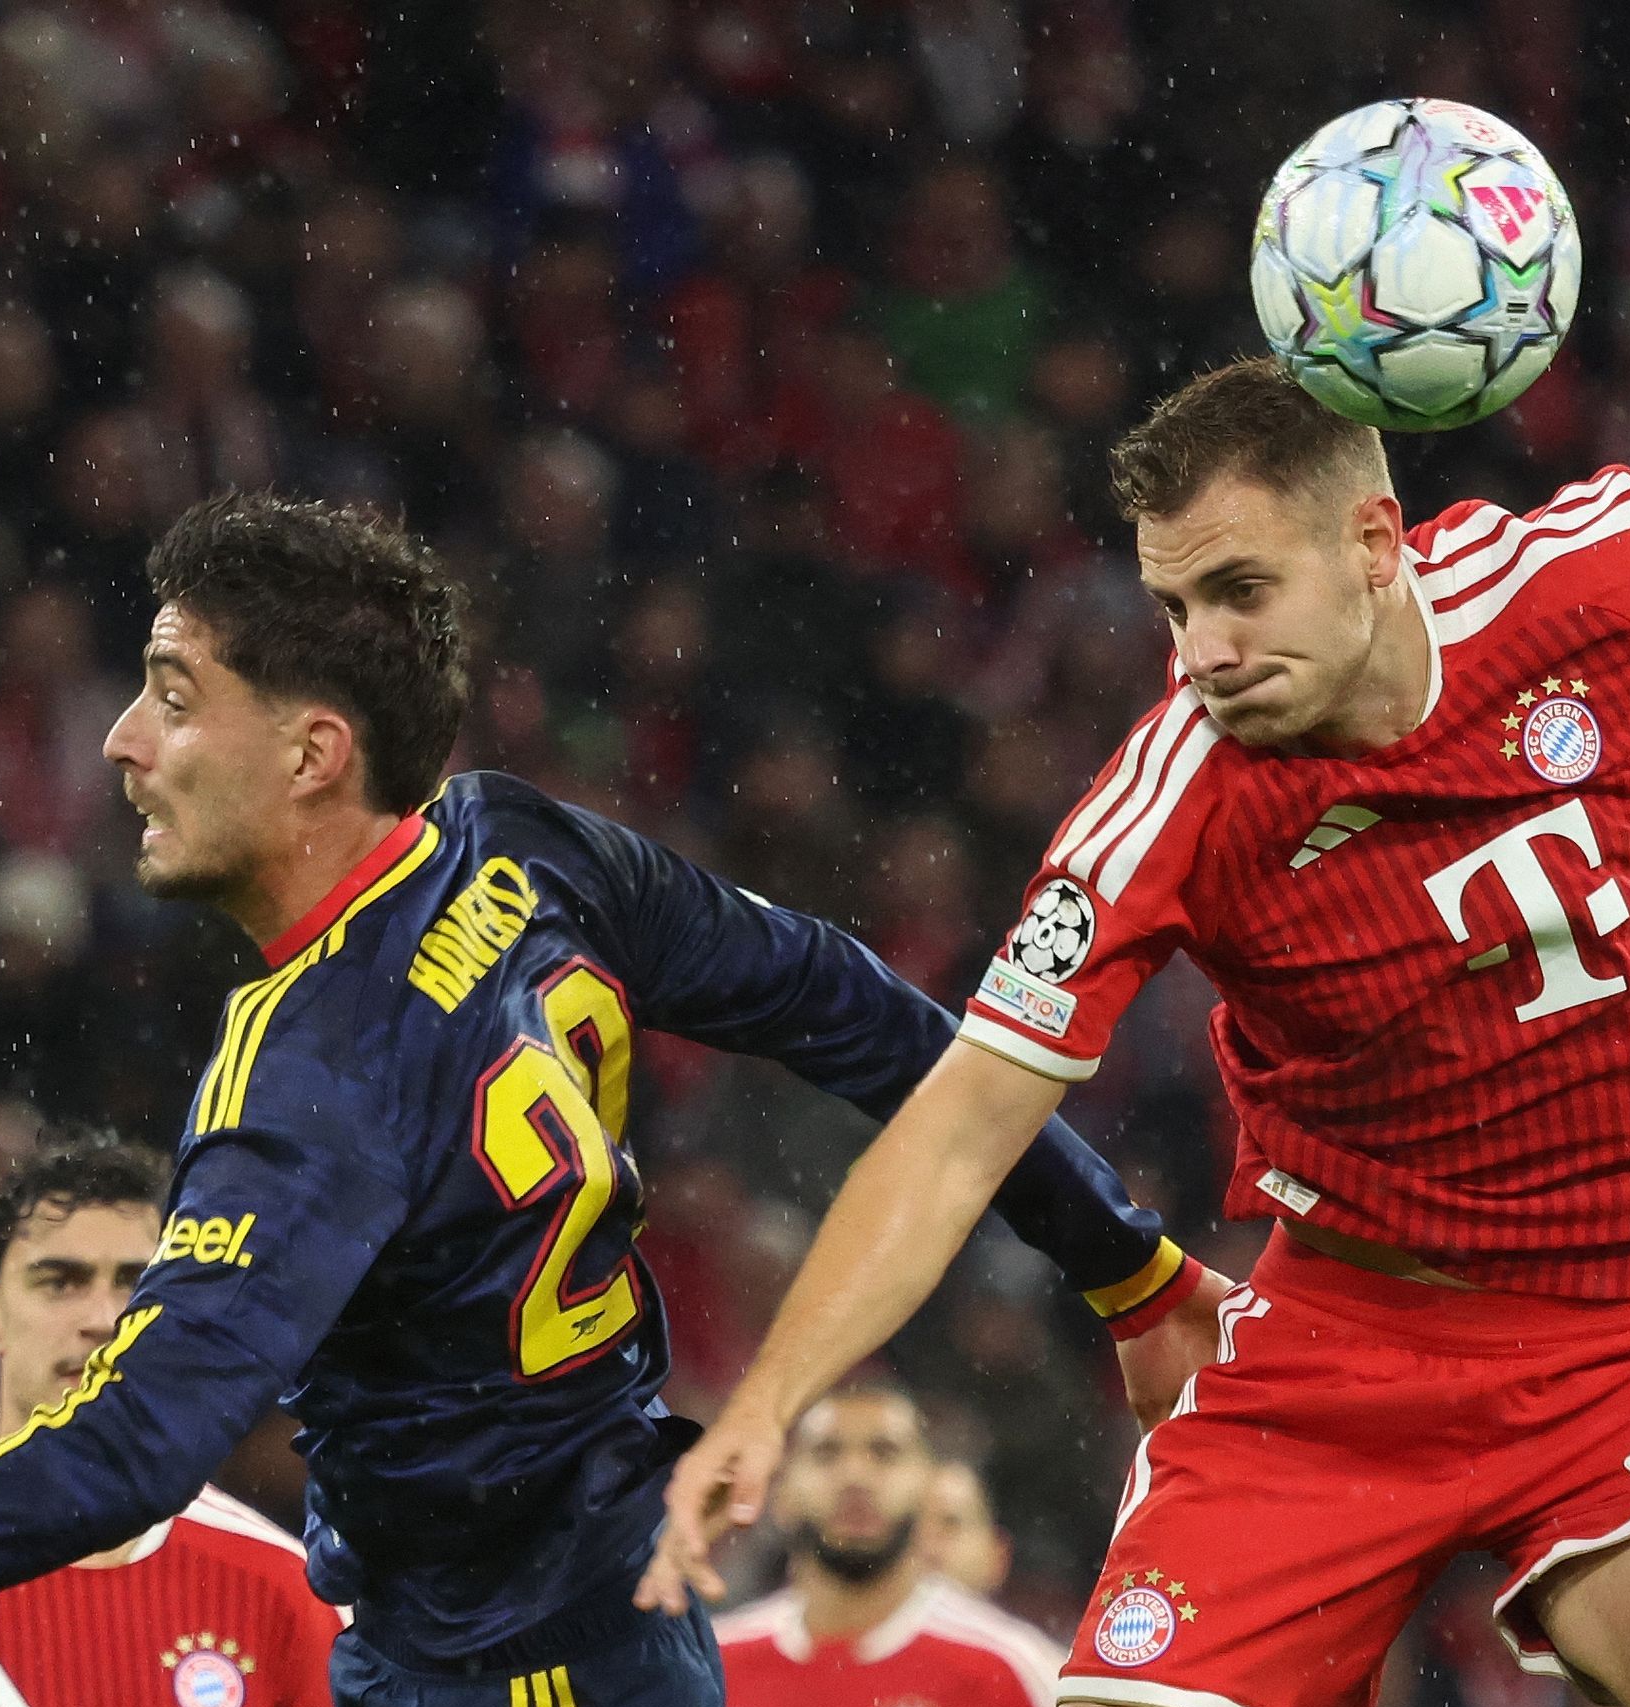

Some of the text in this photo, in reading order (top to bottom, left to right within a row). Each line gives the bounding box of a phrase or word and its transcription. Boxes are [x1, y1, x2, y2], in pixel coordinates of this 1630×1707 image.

[1532, 704, 1582, 732] BAYERN
[1423, 797, 1630, 1023] T
[1127, 1594, 1168, 1628] BAYERN
